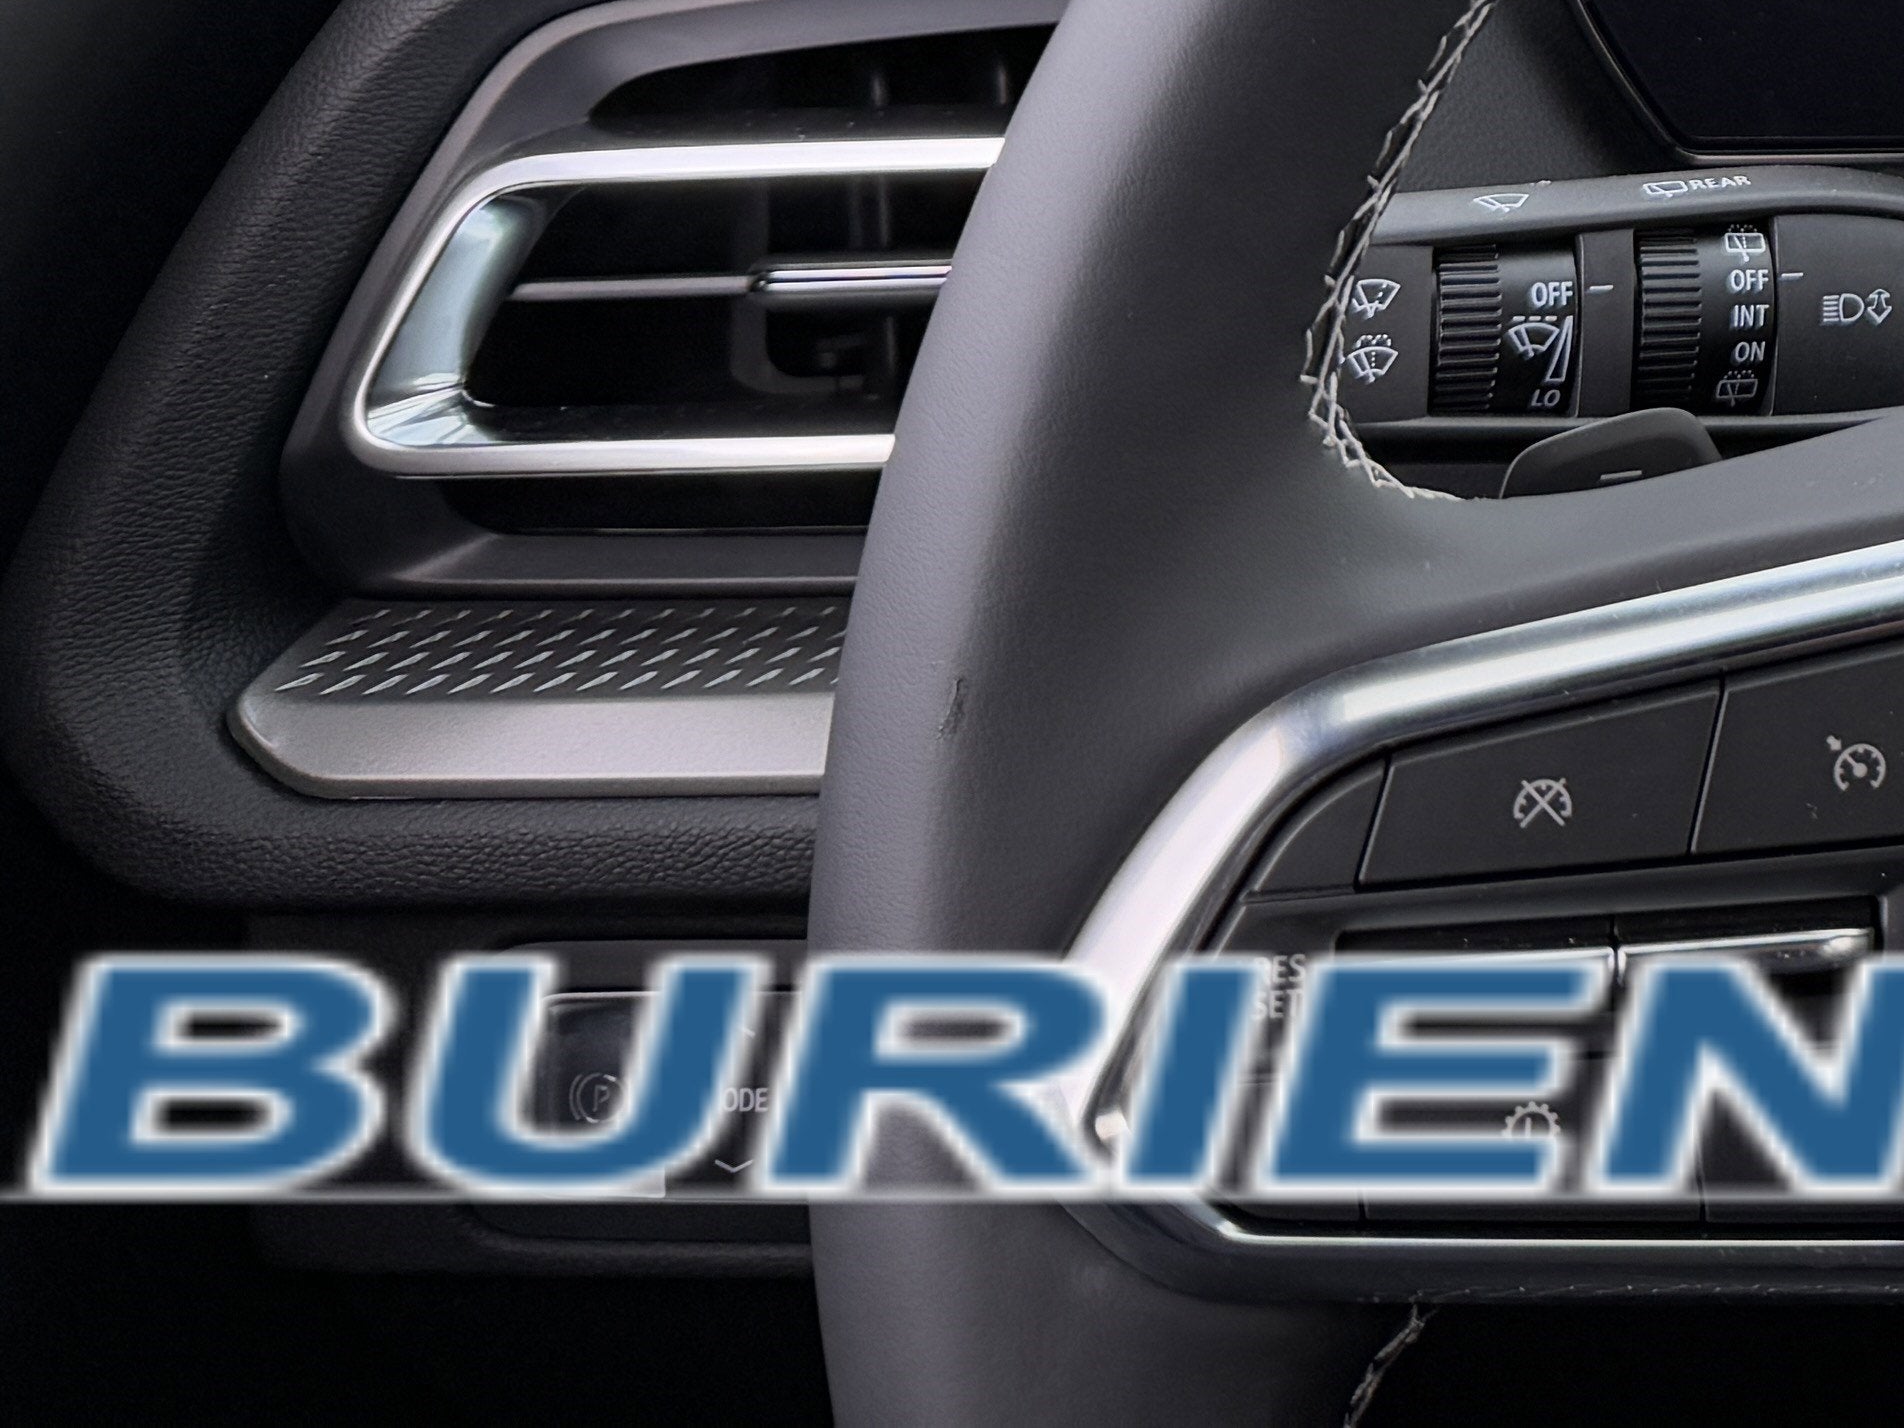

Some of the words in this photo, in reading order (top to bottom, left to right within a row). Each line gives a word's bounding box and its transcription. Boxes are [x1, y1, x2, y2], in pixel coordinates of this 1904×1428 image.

[1691, 175, 1751, 191] REAR
[1730, 270, 1769, 291] OFF
[1530, 282, 1573, 308] OFF
[1732, 305, 1769, 328] INT
[1734, 341, 1766, 363] ON
[1530, 388, 1561, 410] LO
